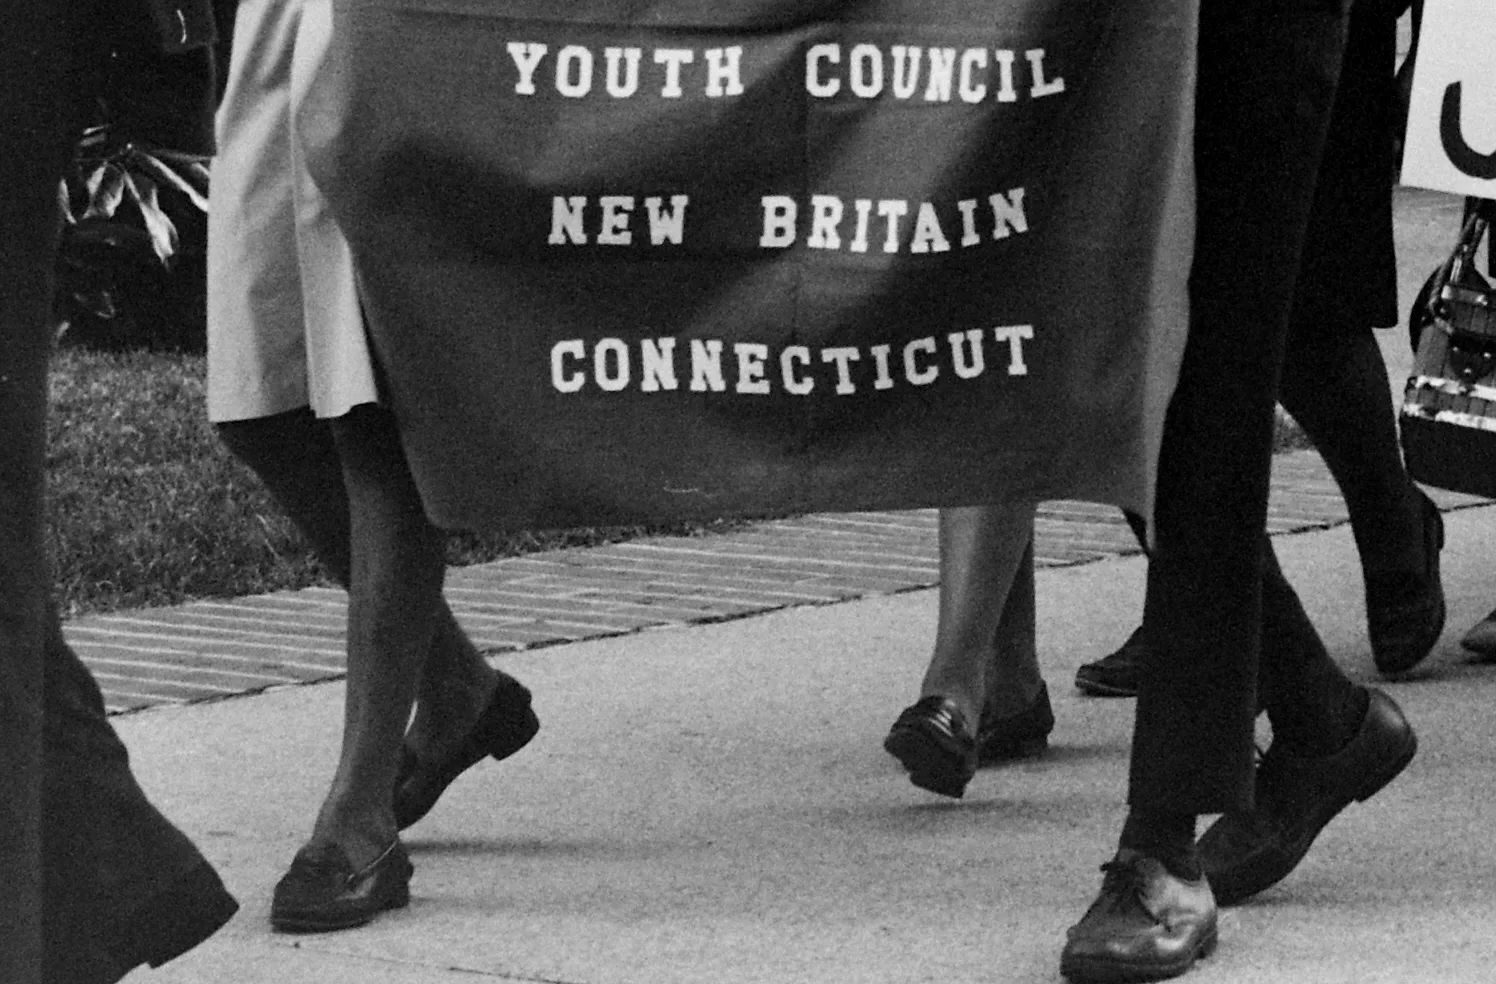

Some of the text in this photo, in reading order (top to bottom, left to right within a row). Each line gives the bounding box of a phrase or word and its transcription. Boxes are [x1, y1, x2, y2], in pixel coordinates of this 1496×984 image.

[507, 42, 1065, 103] YOUTH COUNCIL
[548, 188, 1028, 254] NEW BRITAIN
[550, 325, 1035, 395] CONNECTICUT
